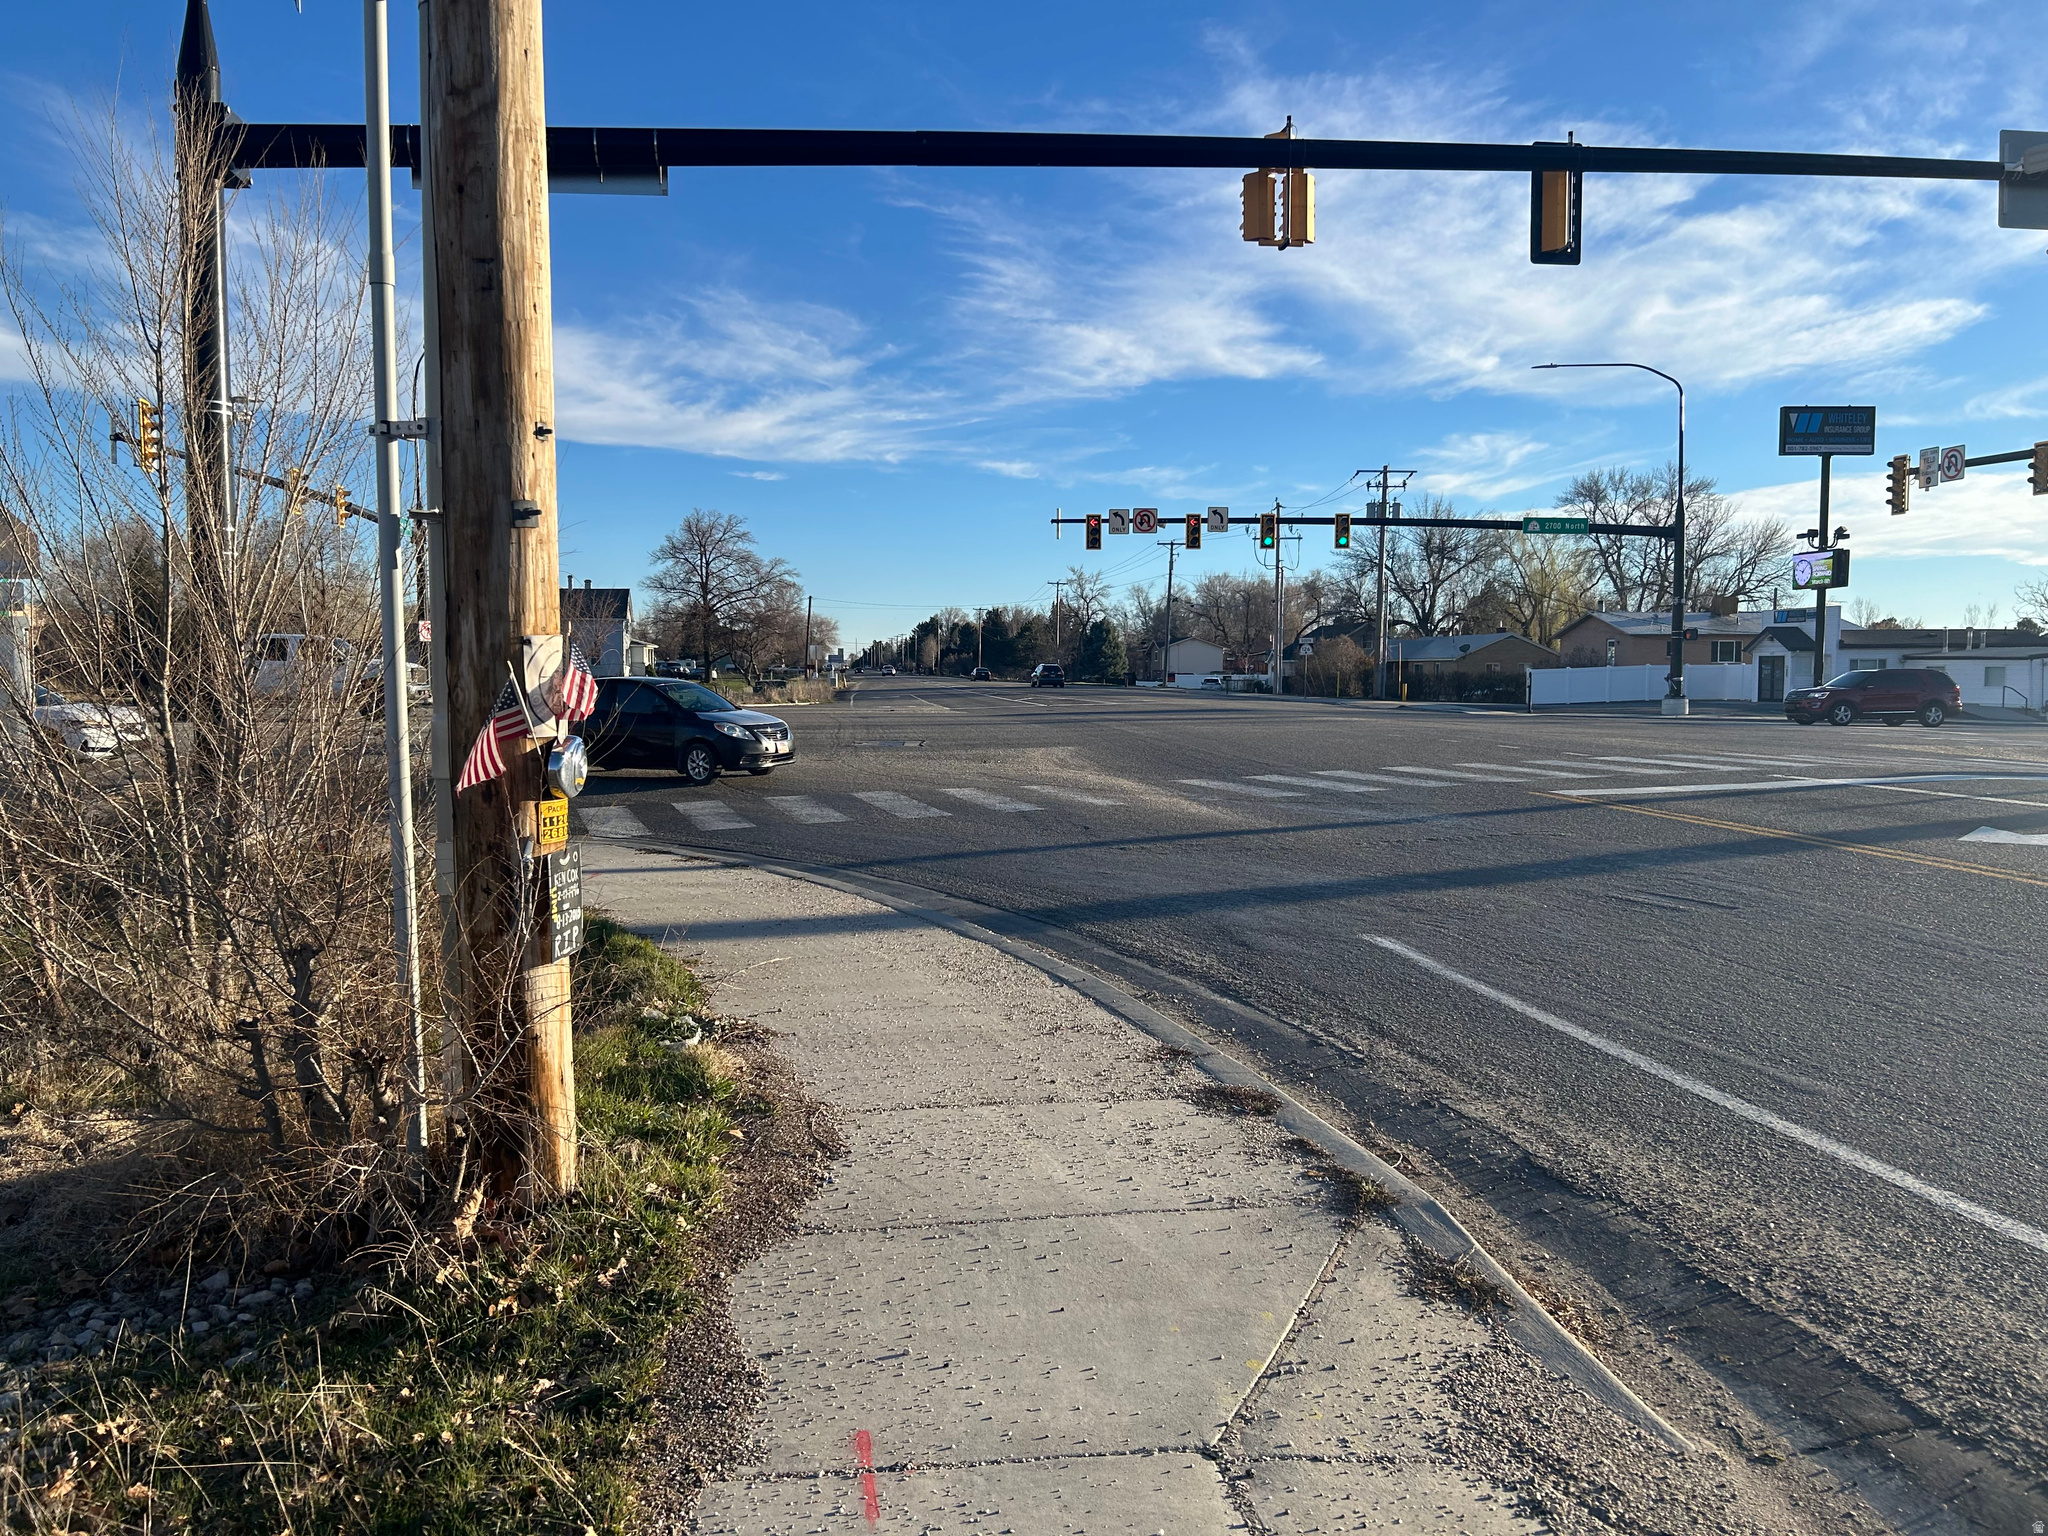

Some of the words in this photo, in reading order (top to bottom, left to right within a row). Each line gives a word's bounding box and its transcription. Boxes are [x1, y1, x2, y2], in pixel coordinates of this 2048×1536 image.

[1828, 412, 1868, 424] WHITELEY
[1823, 425, 1853, 434] INSURANCE
[1853, 425, 1871, 434] GROUP
[1544, 522, 1562, 530] 2700
[554, 870, 567, 888] KEN
[566, 867, 580, 883] COX
[554, 925, 580, 958] R.I.P.
